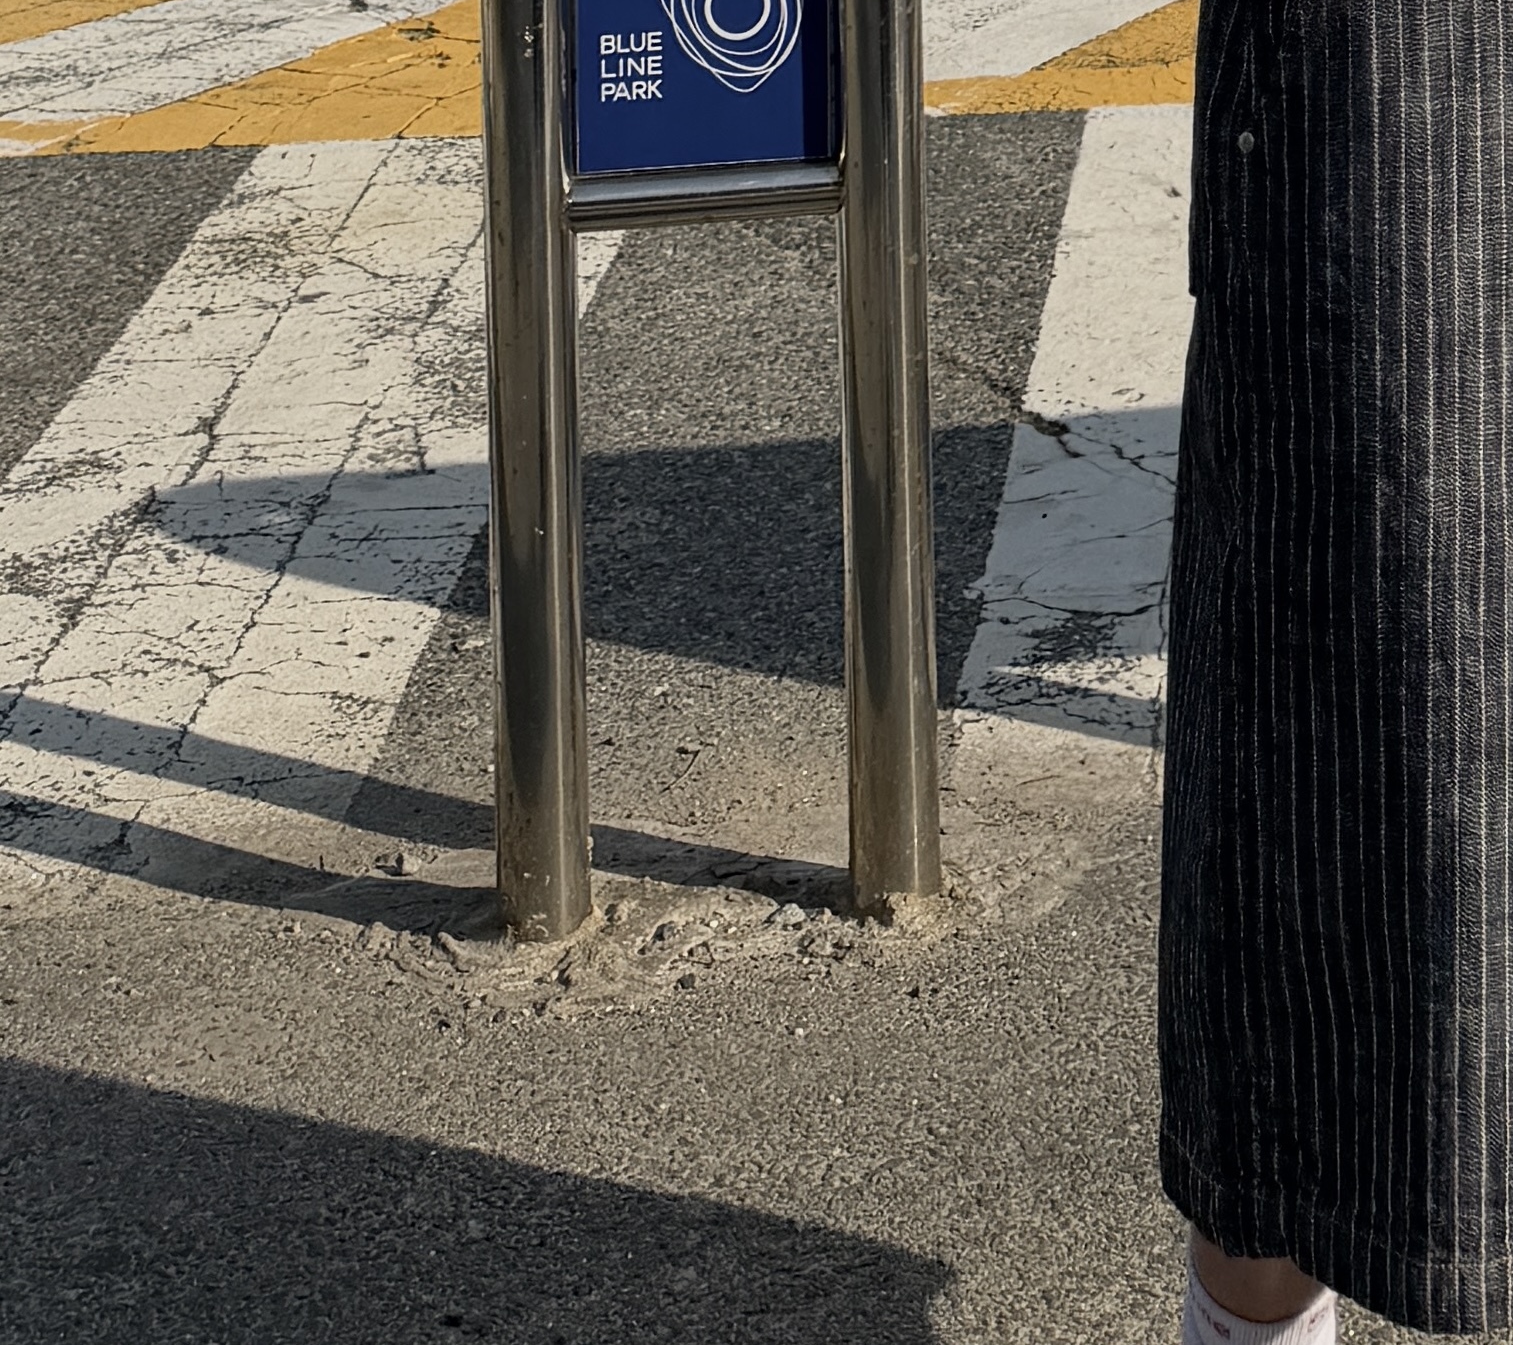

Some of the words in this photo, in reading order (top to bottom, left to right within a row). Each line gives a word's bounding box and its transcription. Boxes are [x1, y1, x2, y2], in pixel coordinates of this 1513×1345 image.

[600, 31, 663, 55] BLUE
[600, 55, 663, 79] LINE
[601, 79, 663, 103] PARK
